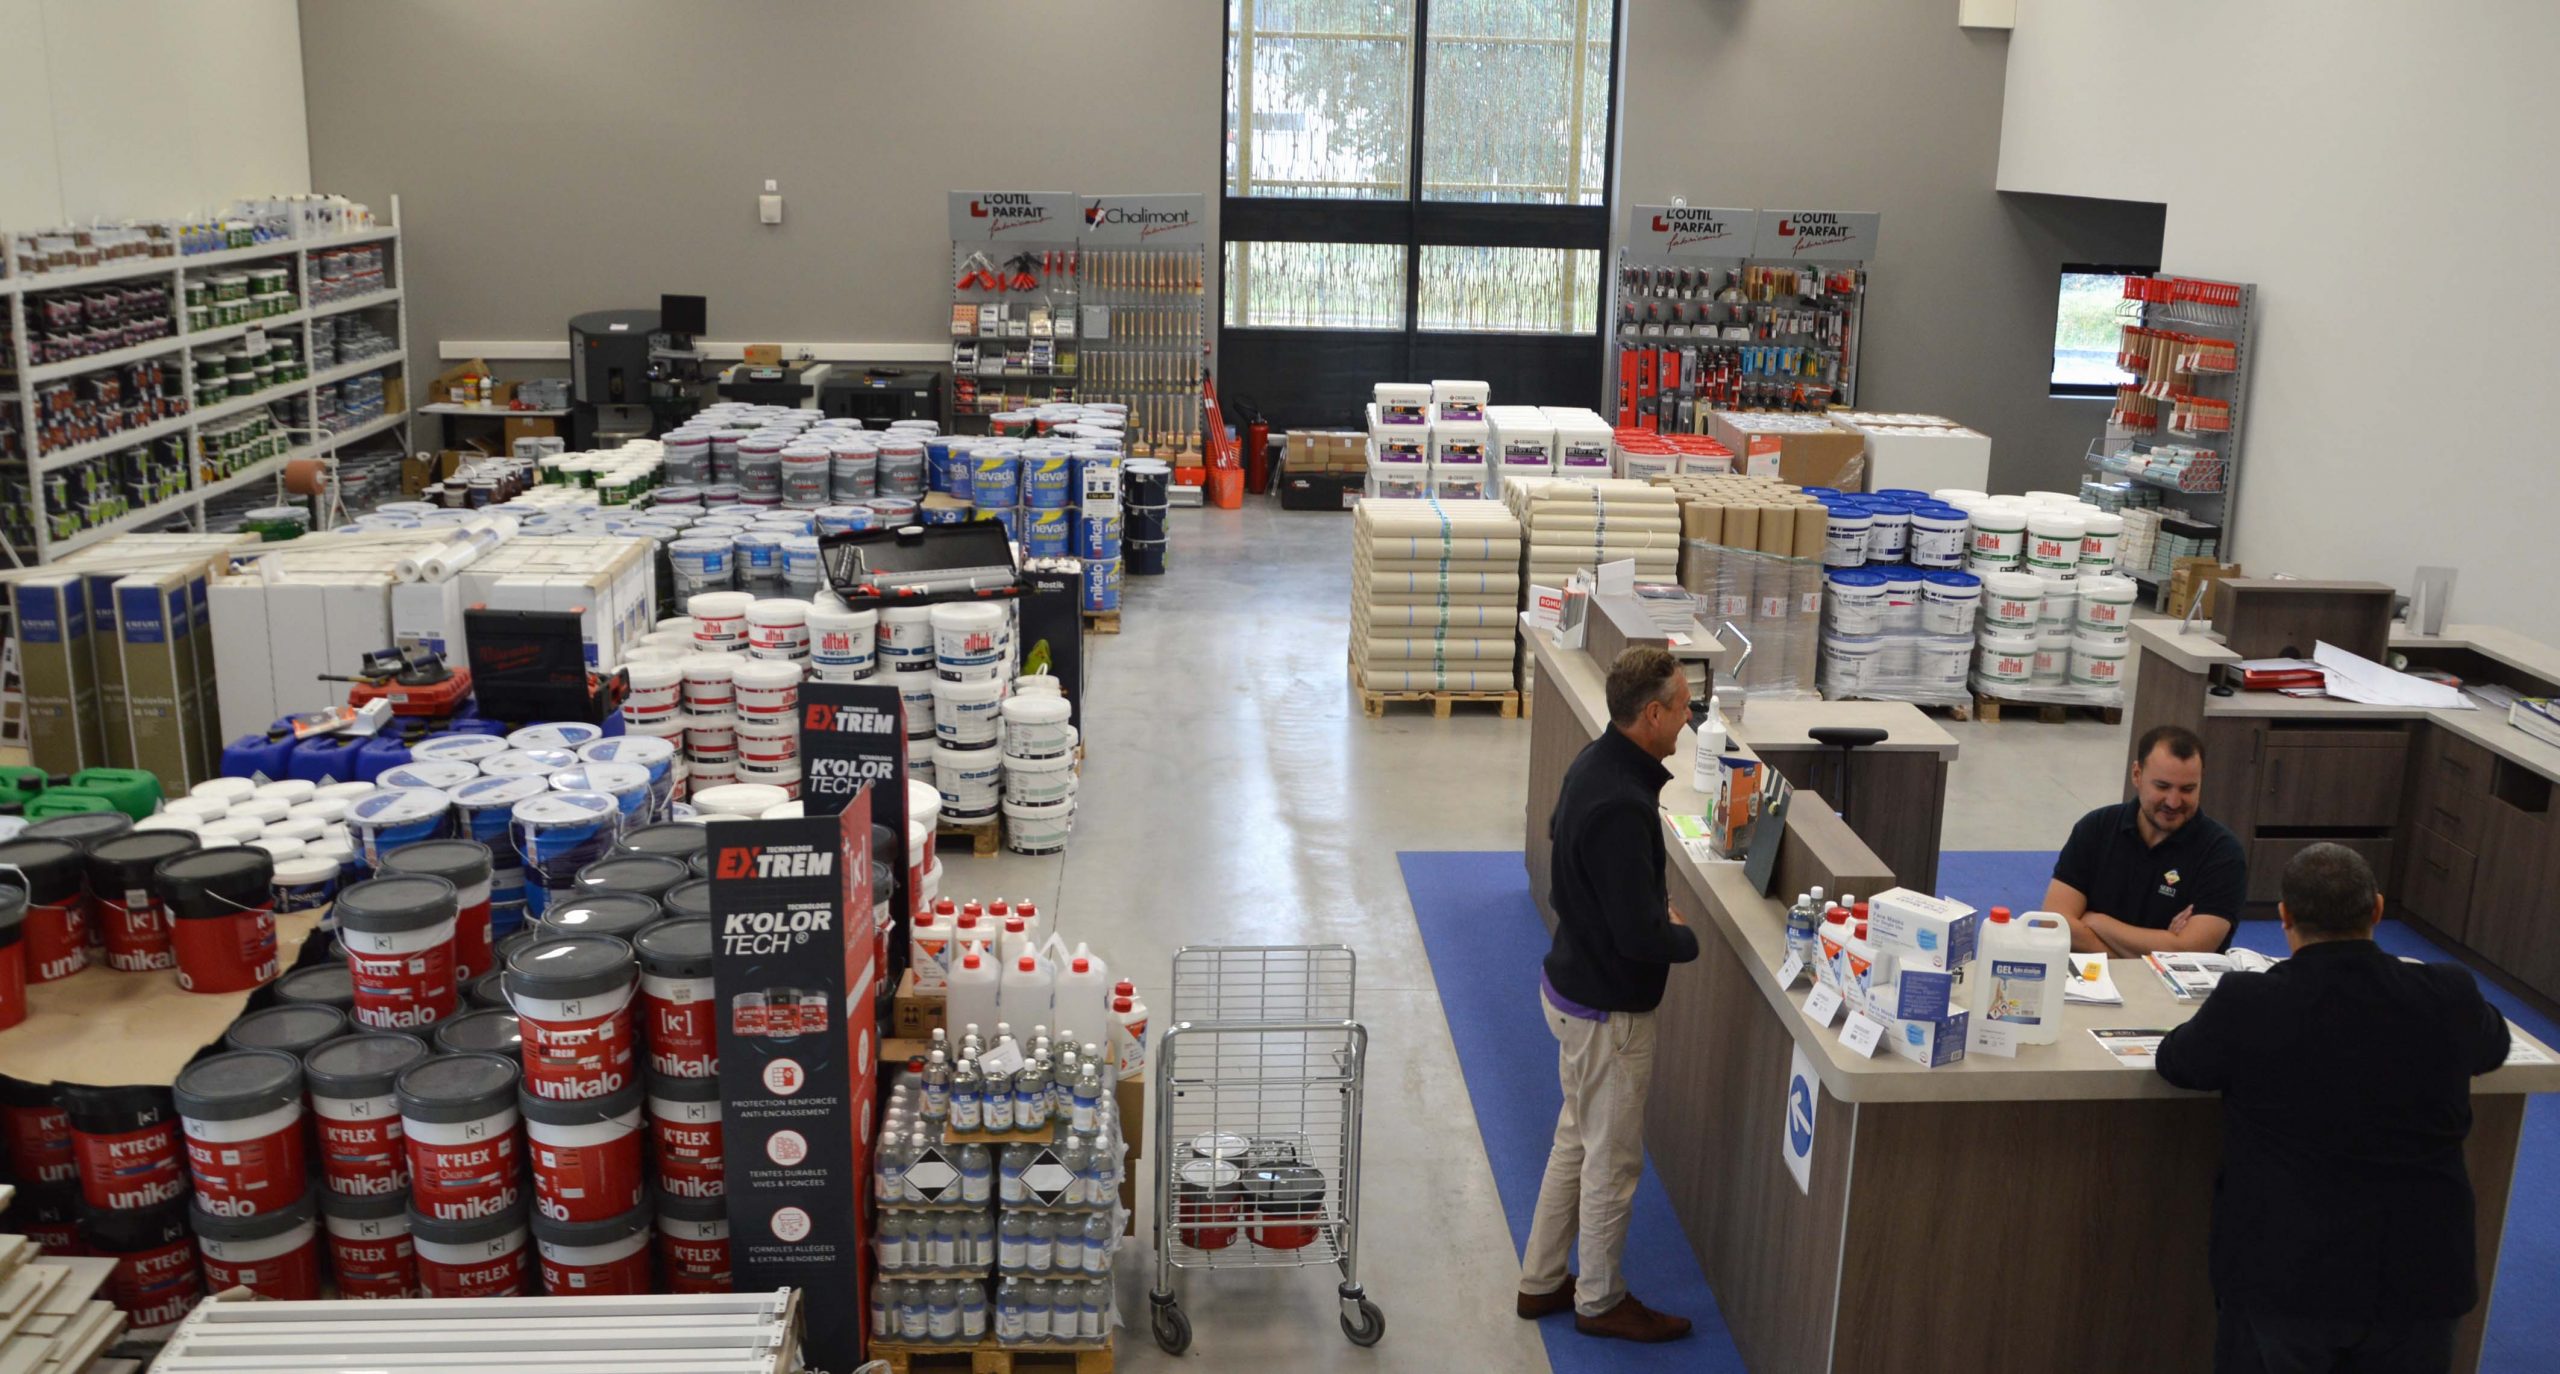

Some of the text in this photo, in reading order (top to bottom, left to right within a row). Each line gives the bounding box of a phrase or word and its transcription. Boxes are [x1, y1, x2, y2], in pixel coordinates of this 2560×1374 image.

[983, 193, 1031, 205] L'OUTIL
[992, 206, 1044, 218] PARFAIT
[1105, 206, 1189, 224] Chalimont
[1666, 209, 1713, 221] L'OUTIL
[1792, 212, 1838, 224] L'OUTIL
[1673, 222, 1724, 233] PARFAIT
[1799, 226, 1848, 237] PARFAIT
[1034, 469, 1068, 483] nevad
[1032, 521, 1067, 534] nevad
[1977, 533, 2000, 550] alltek
[2036, 540, 2062, 557] alltek
[1037, 580, 1065, 589] Bostik
[1540, 598, 1561, 609] RONU
[2000, 601, 2026, 618] alltek
[2090, 604, 2117, 621] alltek
[821, 631, 850, 651] alltek
[964, 631, 990, 652] alltek
[1998, 658, 2023, 673] alltek
[2090, 661, 2115, 676] alltek
[805, 703, 894, 734] EXTREM
[766, 845, 814, 854] TECHNOLOGIE
[716, 846, 833, 880] EXTREM
[724, 911, 832, 935] K'OLOR
[41, 947, 85, 980] unik
[1996, 964, 2013, 974] GEL
[357, 1004, 436, 1029] unikalo
[534, 1071, 623, 1100] unikalo
[731, 1100, 787, 1108] PROTECTION
[740, 1108, 830, 1118] ANTI-ENCRASSEMENT
[327, 1127, 377, 1143] K'FLEX
[663, 1127, 711, 1146] K'FLEX
[436, 1148, 491, 1168] K'FLEX
[749, 1168, 828, 1178] TEINTES DURABLES
[662, 1176, 724, 1199] unika
[751, 1180, 776, 1188] VIVES
[785, 1178, 825, 1187] FONCÉES
[108, 1173, 188, 1210] unikal
[434, 1186, 518, 1221] unikalo
[458, 1263, 511, 1287] K'FLEX
